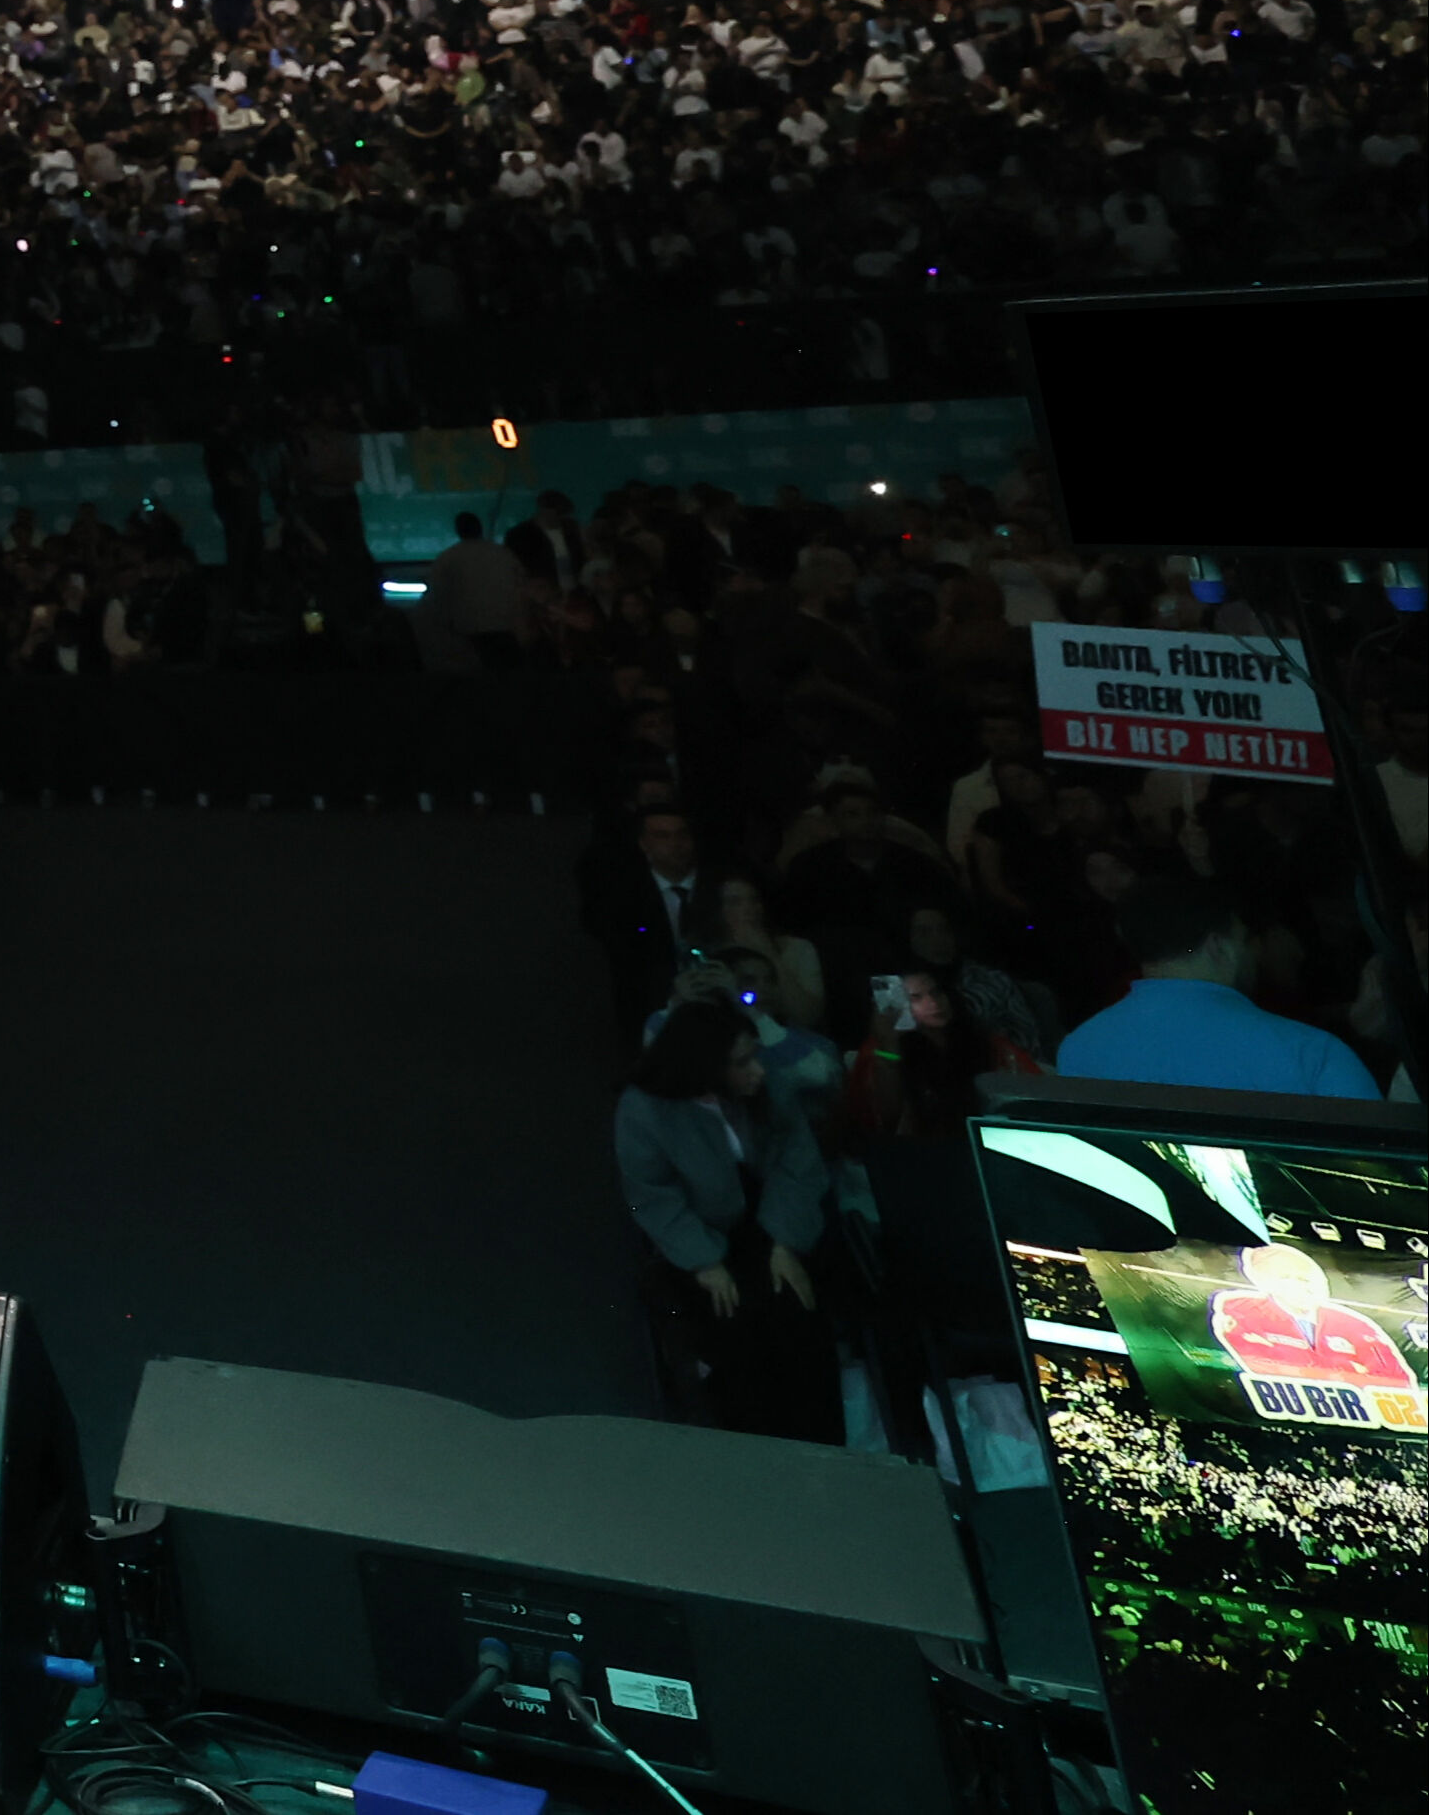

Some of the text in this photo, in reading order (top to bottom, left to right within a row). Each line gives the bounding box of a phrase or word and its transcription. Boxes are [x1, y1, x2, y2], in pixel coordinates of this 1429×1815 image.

[1062, 640, 1292, 684] BANTA, FİLTREYE
[1097, 682, 1263, 722] GEREK YOK!
[1067, 717, 1309, 769] BİZ HEP NETİZ!
[1251, 1379, 1303, 1417] BU
